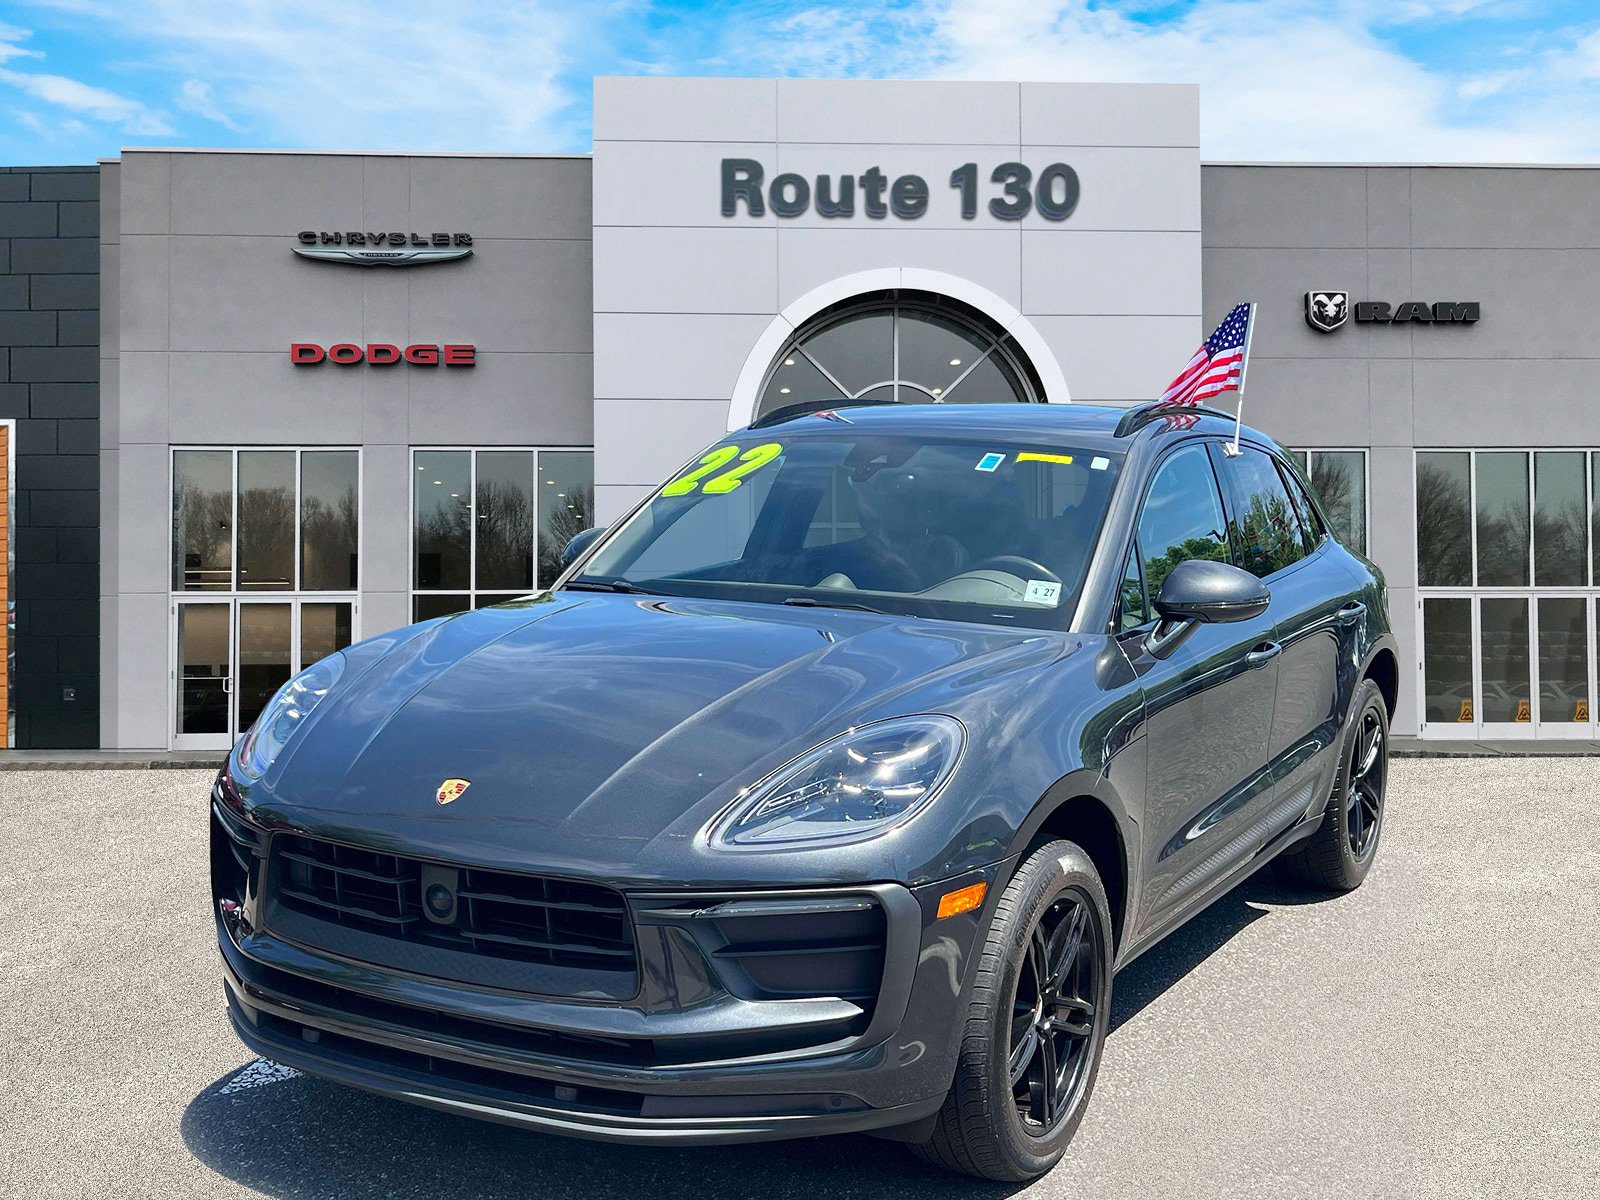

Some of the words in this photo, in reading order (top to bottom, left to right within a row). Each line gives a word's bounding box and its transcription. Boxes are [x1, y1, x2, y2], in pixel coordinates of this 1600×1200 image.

[721, 158, 929, 219] Route
[950, 162, 1080, 221] 130
[298, 231, 473, 246] CHRYSLER
[1354, 302, 1480, 323] RAM
[291, 343, 476, 366] DODGE
[661, 443, 783, 497] 22
[1043, 588, 1056, 597] 27
